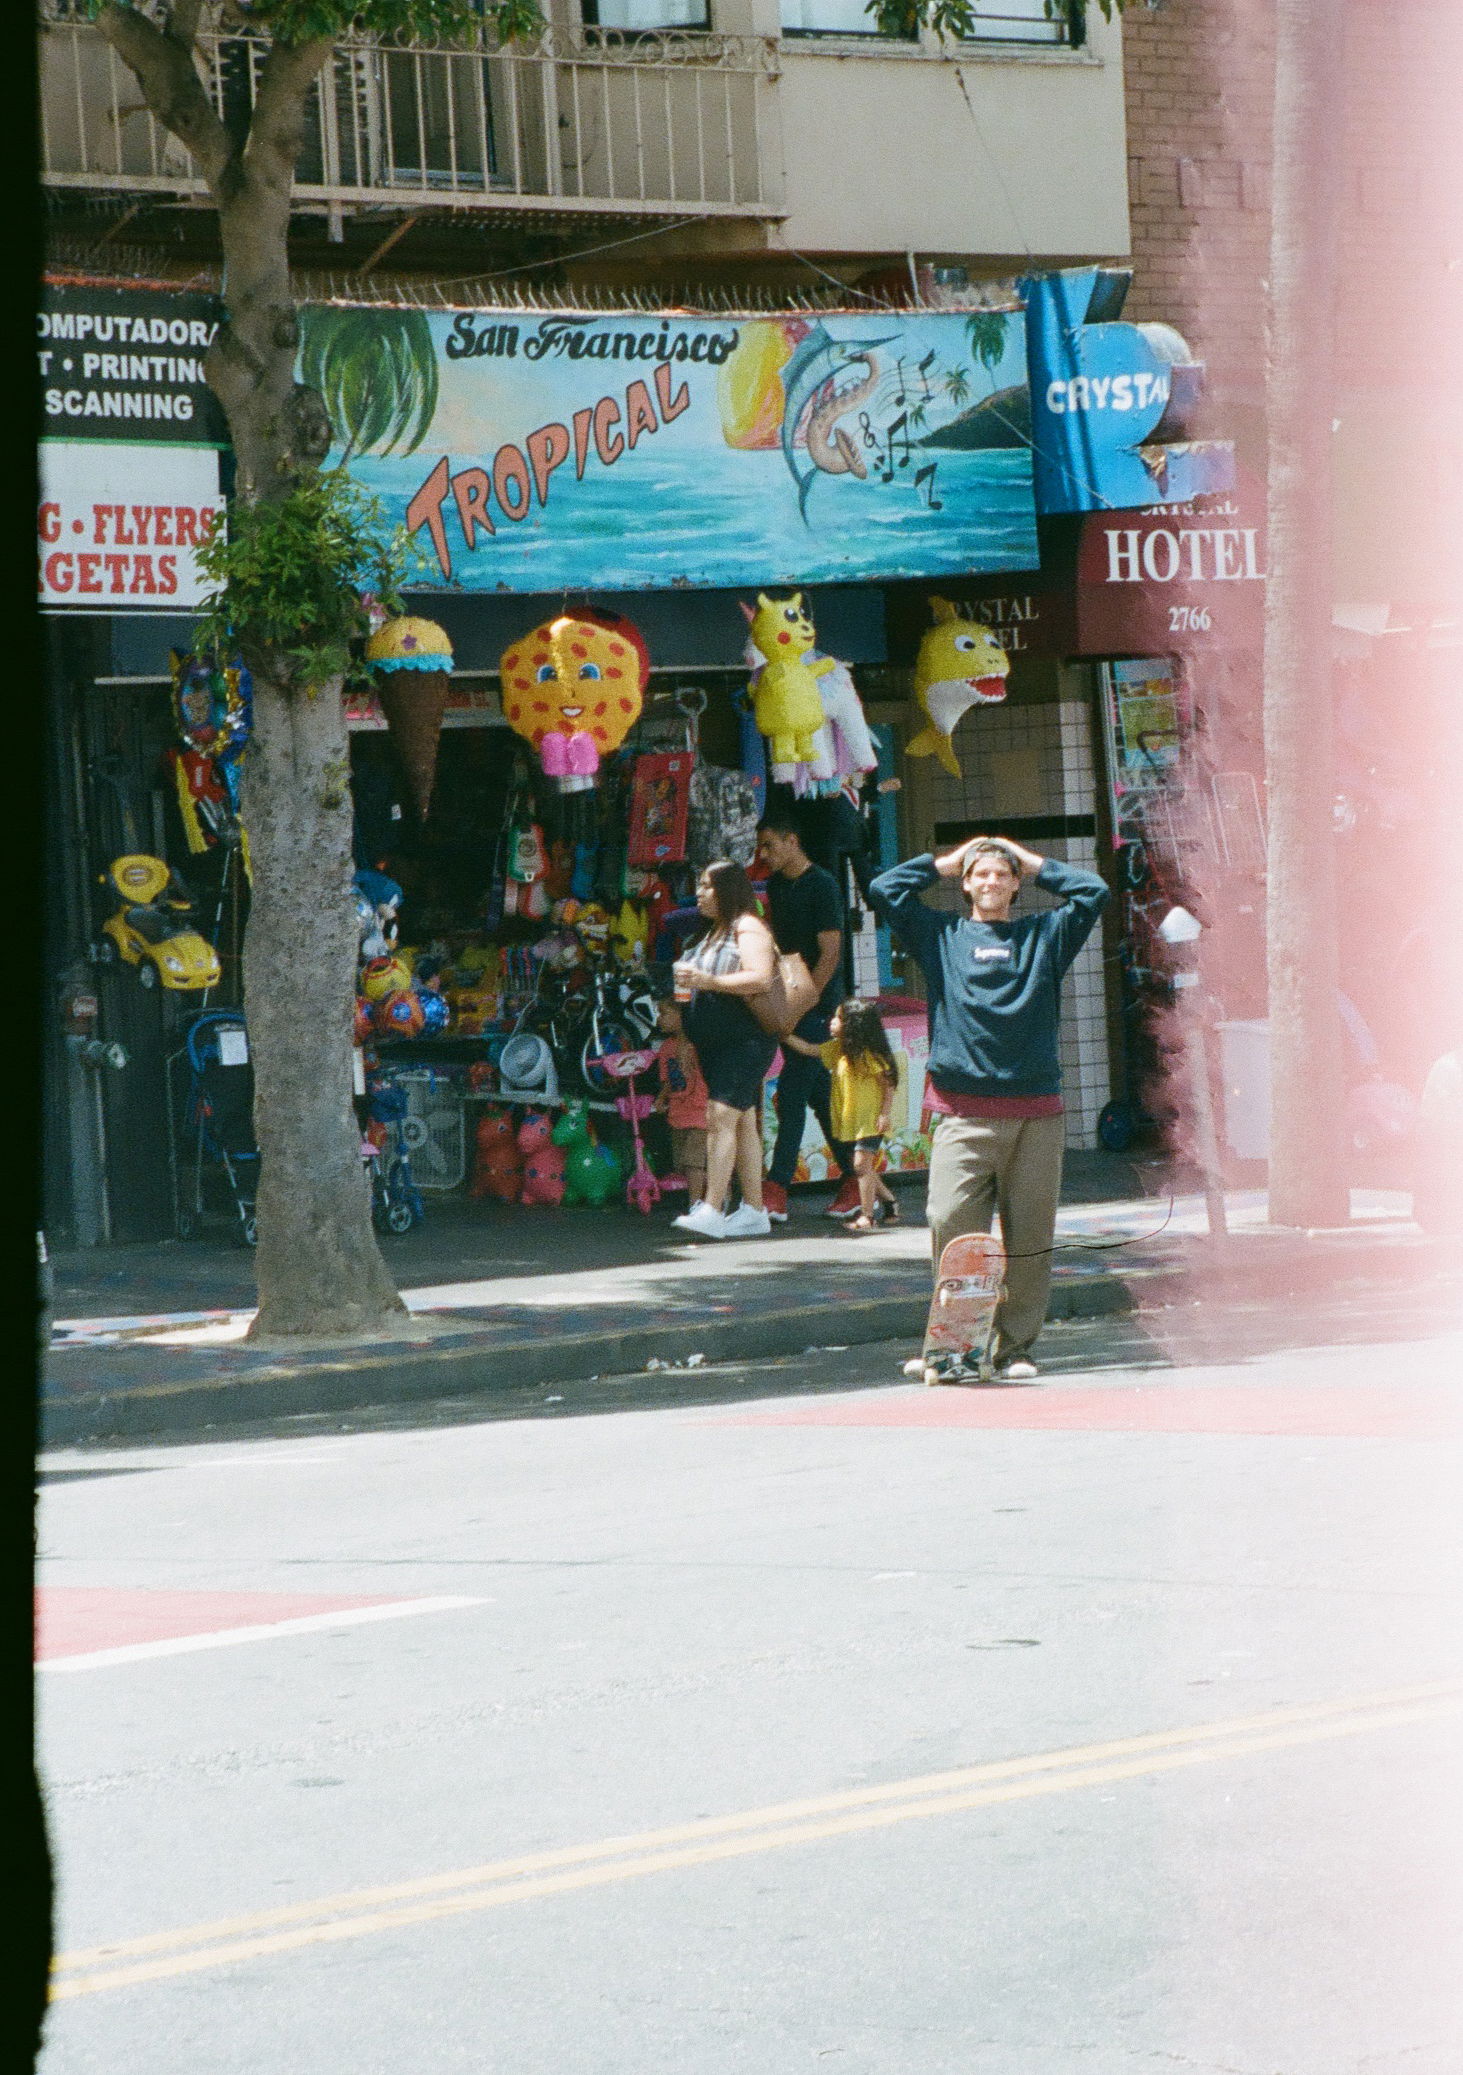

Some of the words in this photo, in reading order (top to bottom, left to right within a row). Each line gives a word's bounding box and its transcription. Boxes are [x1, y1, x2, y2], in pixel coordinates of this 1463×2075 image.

[446, 312, 519, 360] San
[524, 314, 739, 365] Francisco
[45, 388, 194, 420] SCANNING
[405, 360, 690, 580] TROPICAL
[93, 504, 216, 546] FLYERS
[37, 552, 178, 595] GETAS
[1104, 528, 1267, 582] HOTEL
[1168, 606, 1211, 632] 2766
